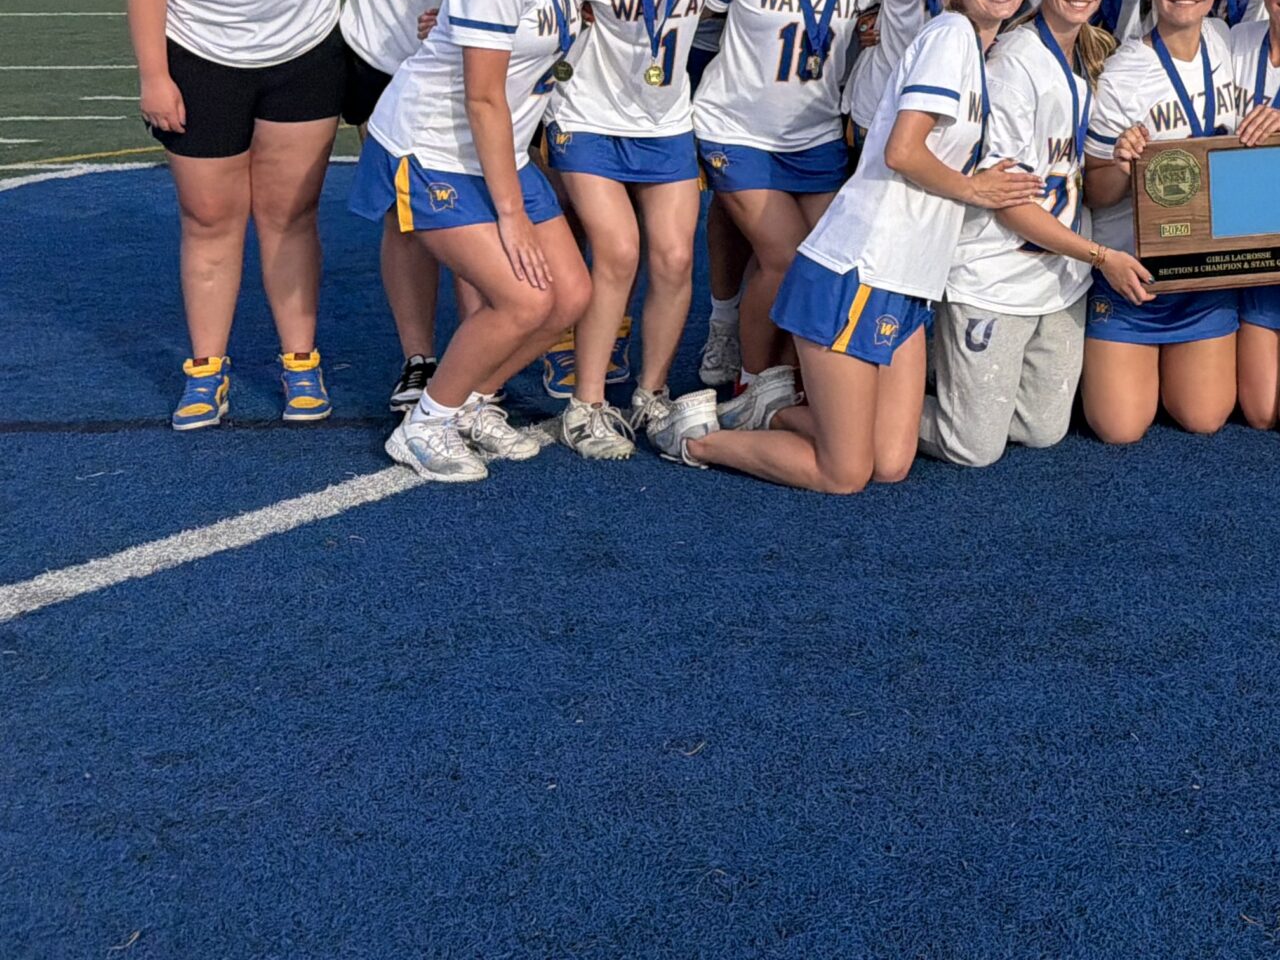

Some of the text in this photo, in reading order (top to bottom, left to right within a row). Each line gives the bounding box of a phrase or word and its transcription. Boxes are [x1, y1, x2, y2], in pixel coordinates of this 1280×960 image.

[1206, 251, 1272, 263] GIRLS LACROSSE
[1158, 267, 1193, 276] SECTION
[1200, 260, 1242, 272] CHAMPION
[1250, 259, 1276, 268] STATE
